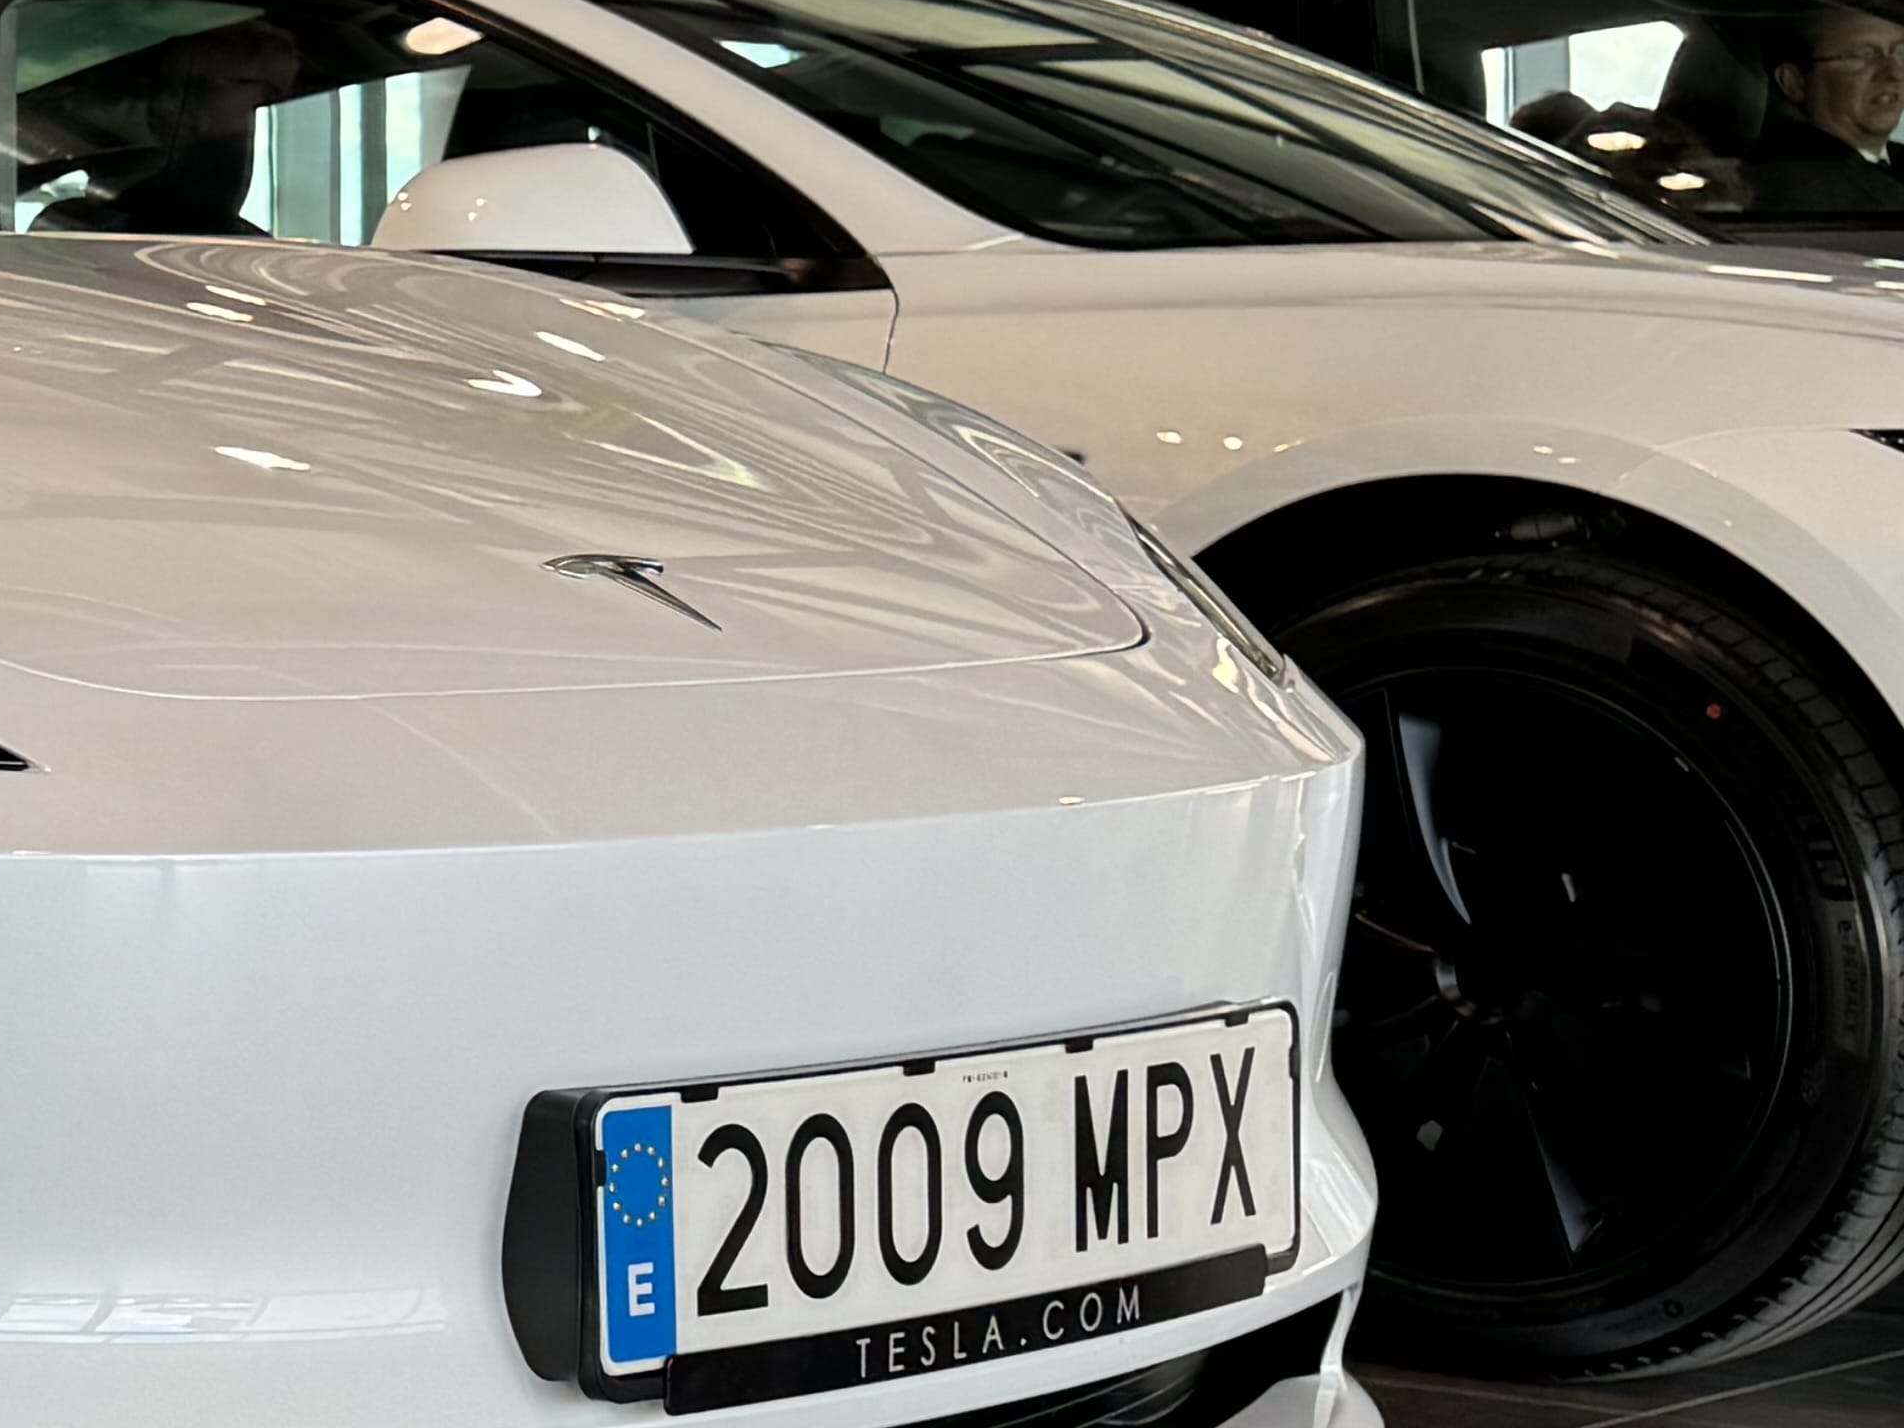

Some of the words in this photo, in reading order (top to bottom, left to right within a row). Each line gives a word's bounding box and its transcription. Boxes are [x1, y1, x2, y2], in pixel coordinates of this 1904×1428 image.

[696, 1090, 1025, 1317] 2009
[1074, 1046, 1257, 1253] MPX
[627, 1261, 655, 1317] E
[855, 1286, 1143, 1380] TESLA.COM
